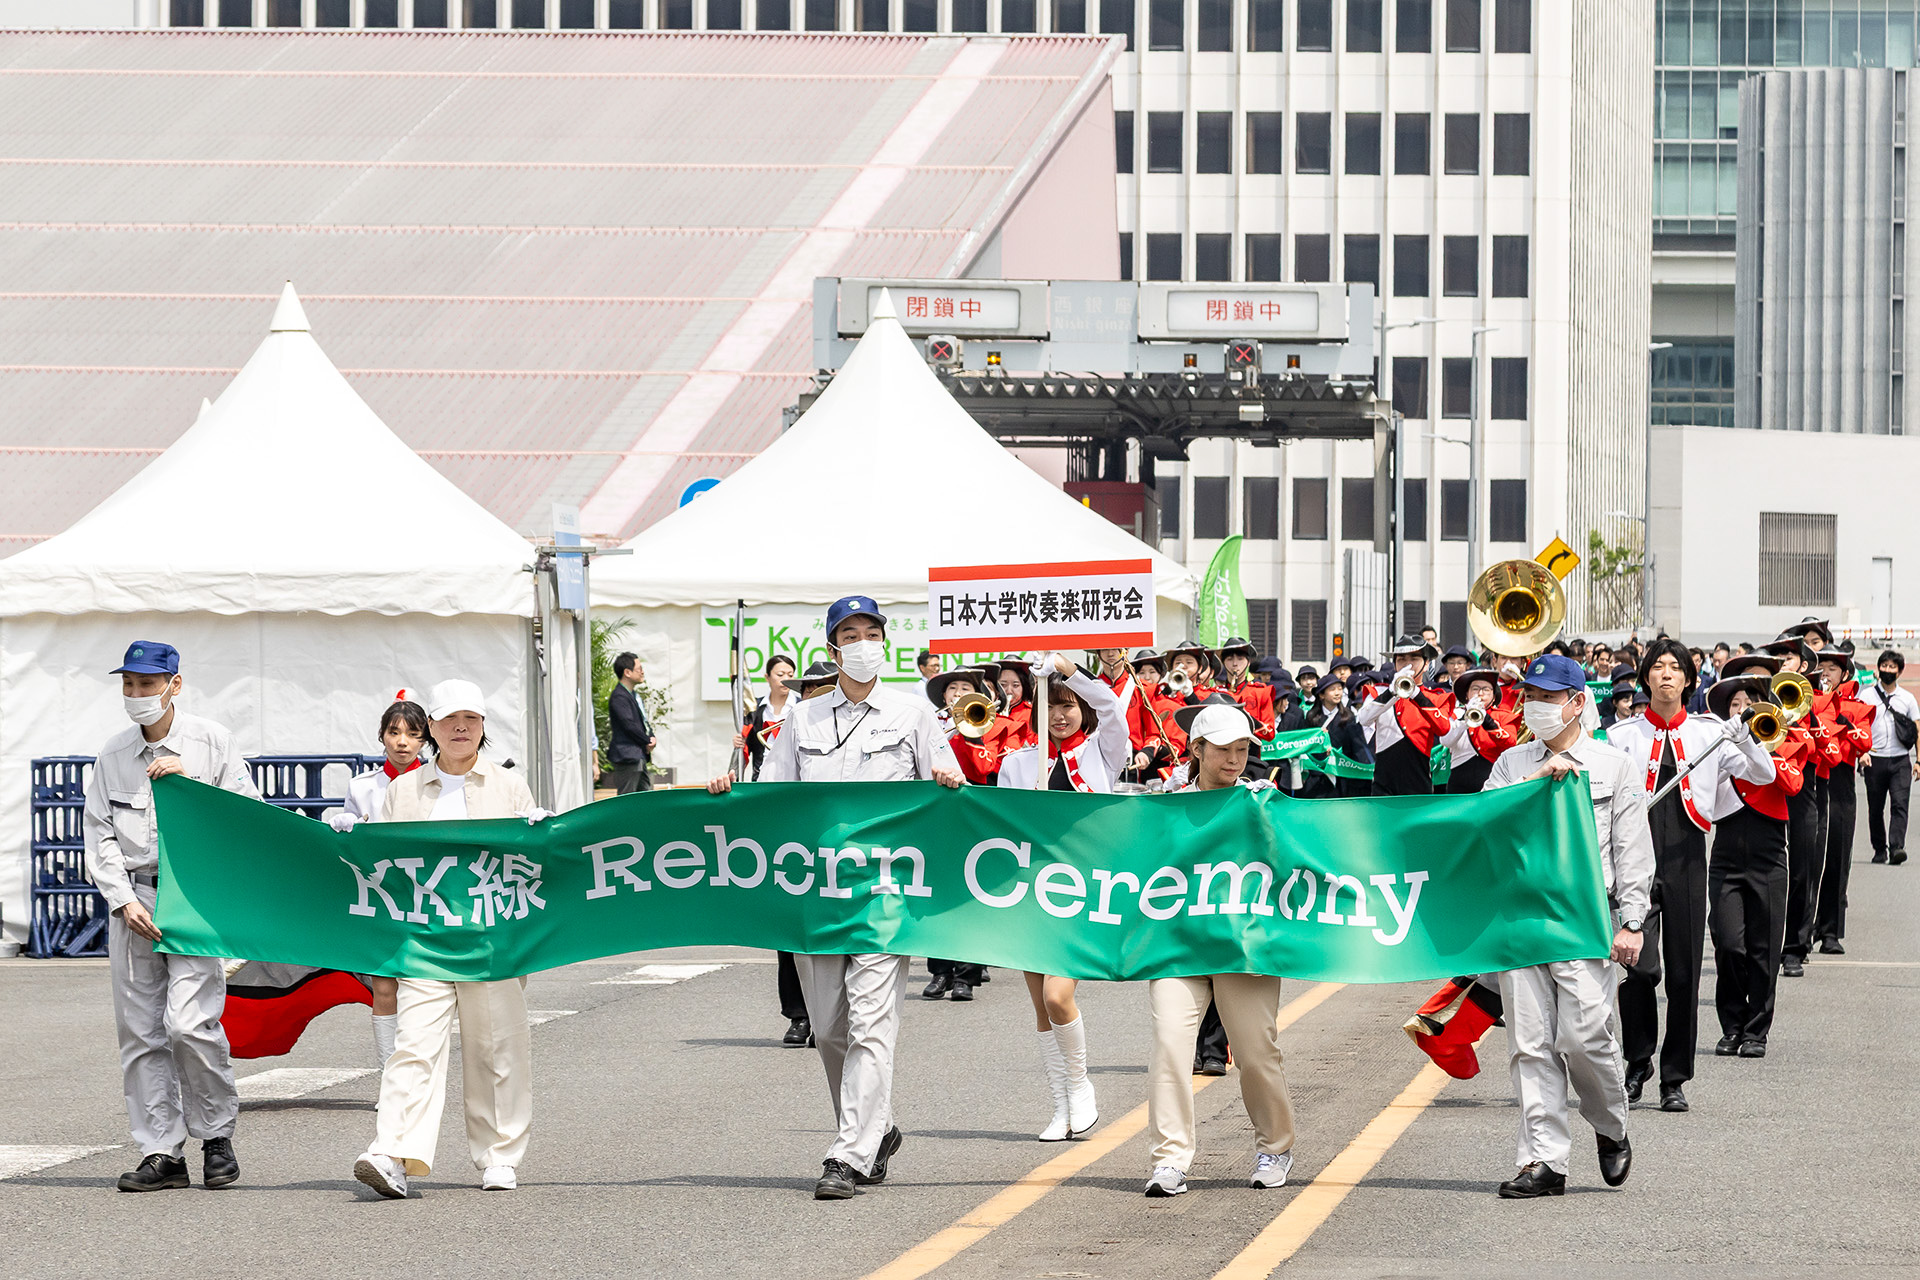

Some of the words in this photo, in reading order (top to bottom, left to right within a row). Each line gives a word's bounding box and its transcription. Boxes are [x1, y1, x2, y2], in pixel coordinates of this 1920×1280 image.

[906, 296, 982, 319] 閉鎖中
[1054, 295, 1133, 314] 西銀座
[1206, 300, 1281, 321] 閉鎖中
[939, 586, 1144, 627] 日本大学吹奏楽研究会
[1276, 736, 1325, 751] Ceremony
[338, 850, 547, 927] KK線
[581, 825, 933, 900] Reborn
[964, 837, 1429, 946] Ceremony
